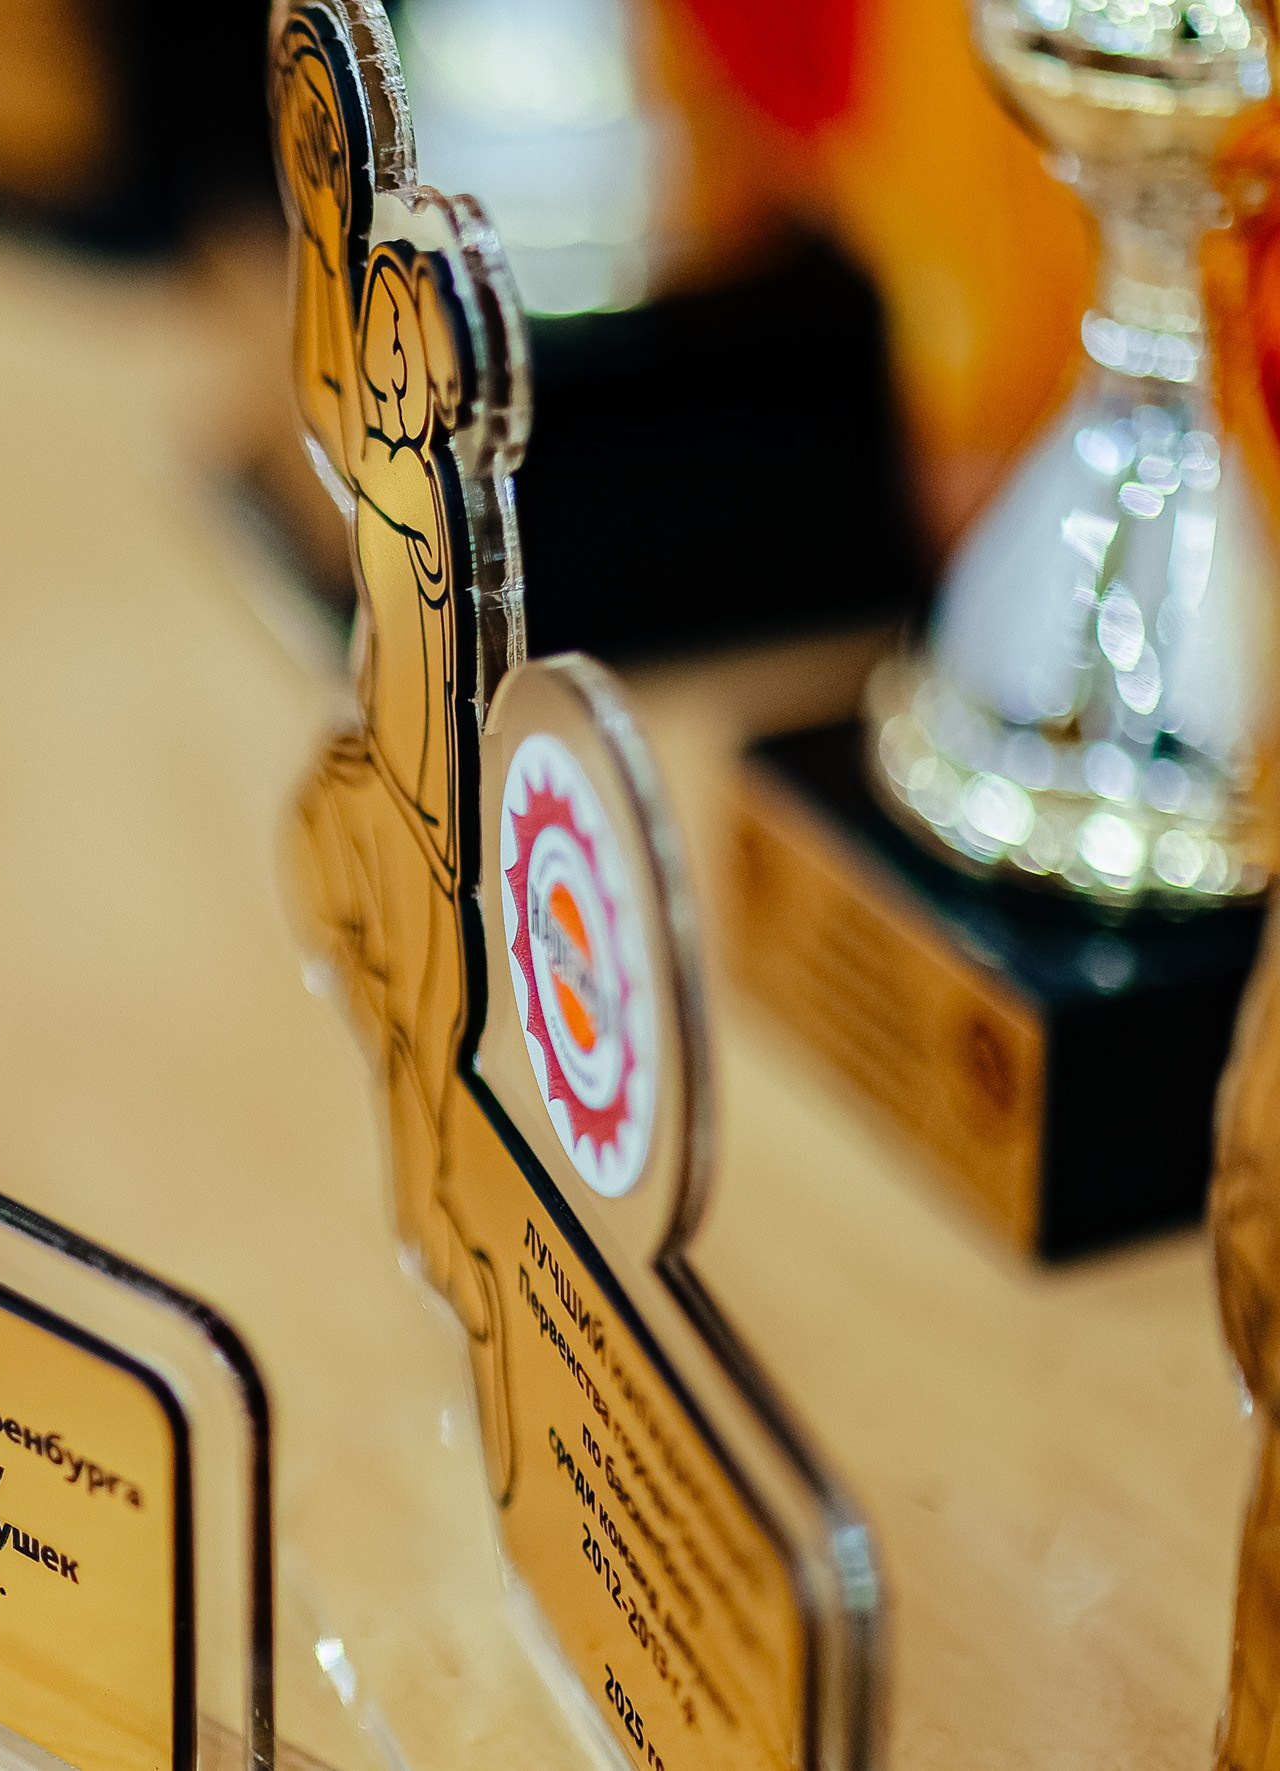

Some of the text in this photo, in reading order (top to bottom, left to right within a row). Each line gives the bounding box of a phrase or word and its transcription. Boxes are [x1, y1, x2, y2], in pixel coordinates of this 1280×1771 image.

[524, 1217, 607, 1368] ЛУЧШИЙ
[519, 1261, 611, 1430] Первенства
[548, 1426, 596, 1516] среди
[582, 1422, 602, 1469] по
[605, 1663, 645, 1750] 2025
